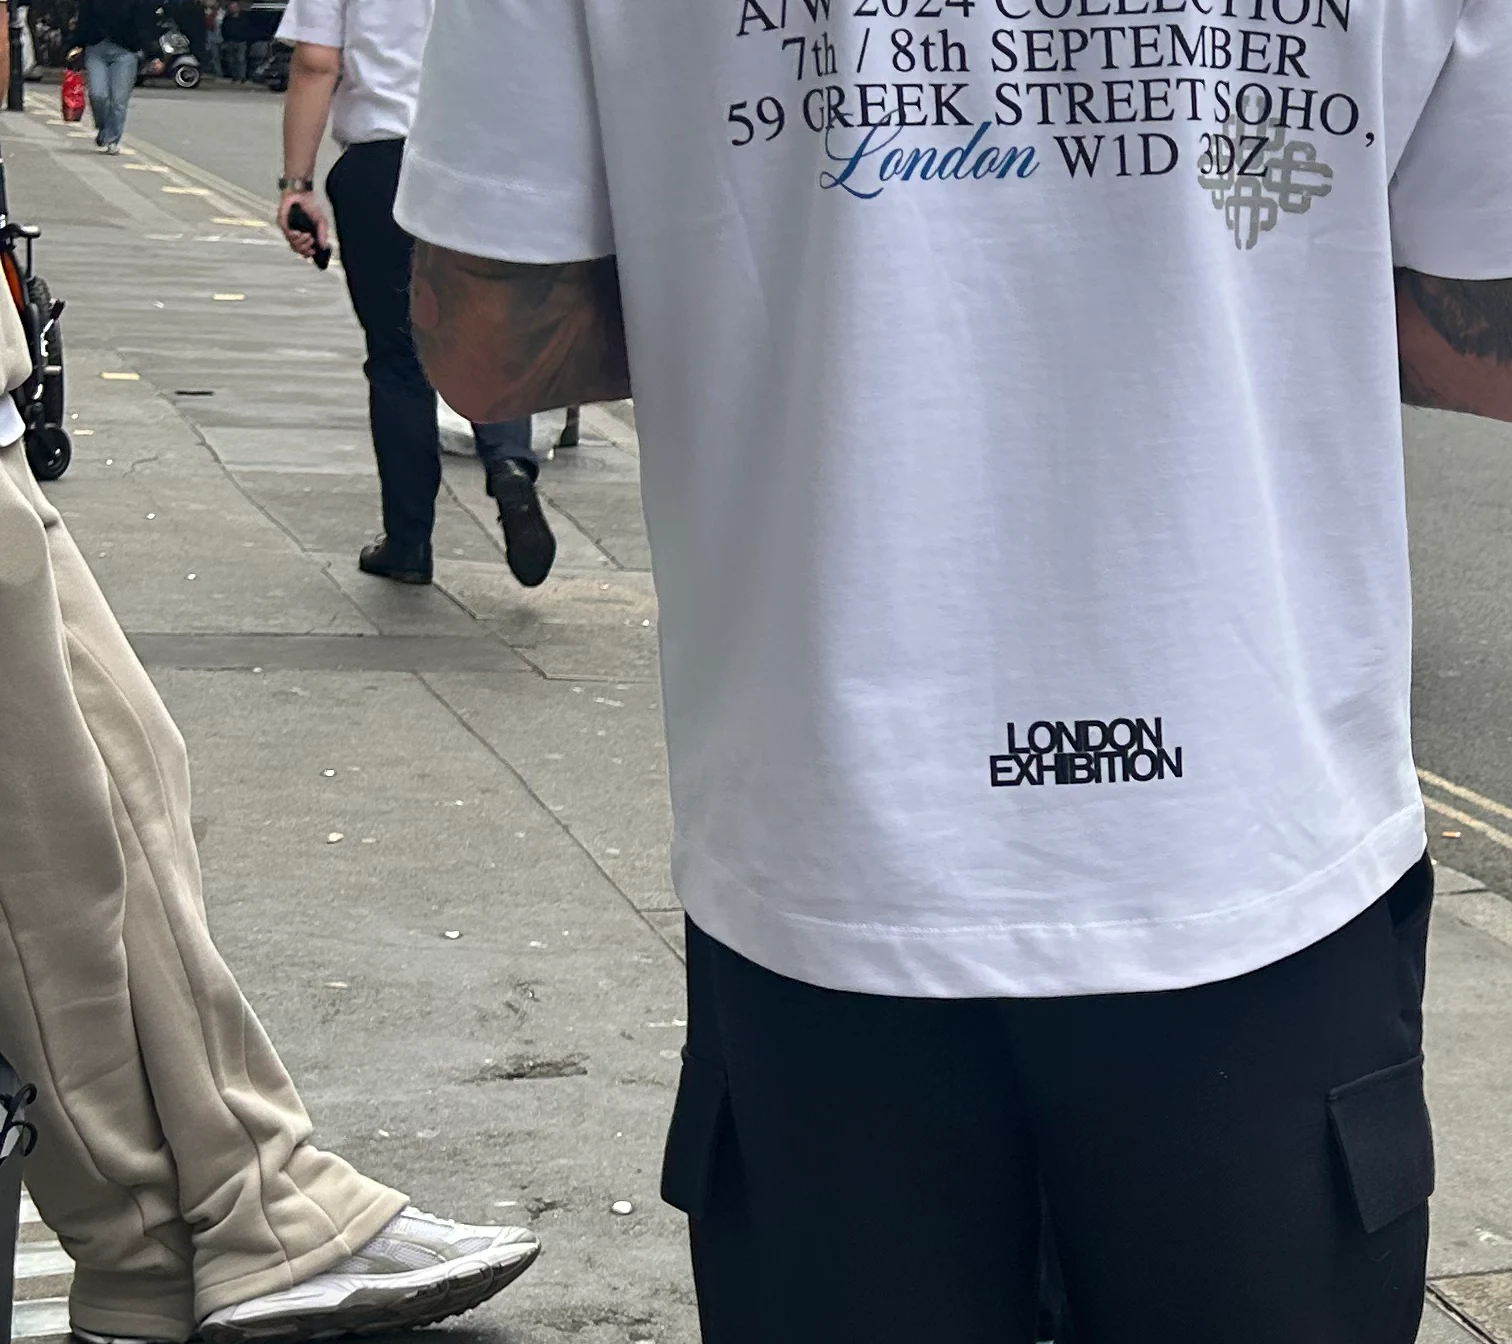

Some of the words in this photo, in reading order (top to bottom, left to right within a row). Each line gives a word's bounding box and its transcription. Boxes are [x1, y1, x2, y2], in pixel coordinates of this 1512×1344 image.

[781, 32, 838, 81] 7th
[856, 27, 871, 73] /
[890, 28, 971, 73] 8th
[990, 24, 1311, 79] SEPTEMBER
[728, 96, 785, 146] 59
[803, 82, 974, 133] GREEK
[820, 108, 1041, 199] London
[1053, 133, 1179, 178] W1D
[1199, 132, 1270, 178] 3DZ
[1007, 717, 1163, 754] LONDON
[989, 746, 1183, 787] EXHIBITION
